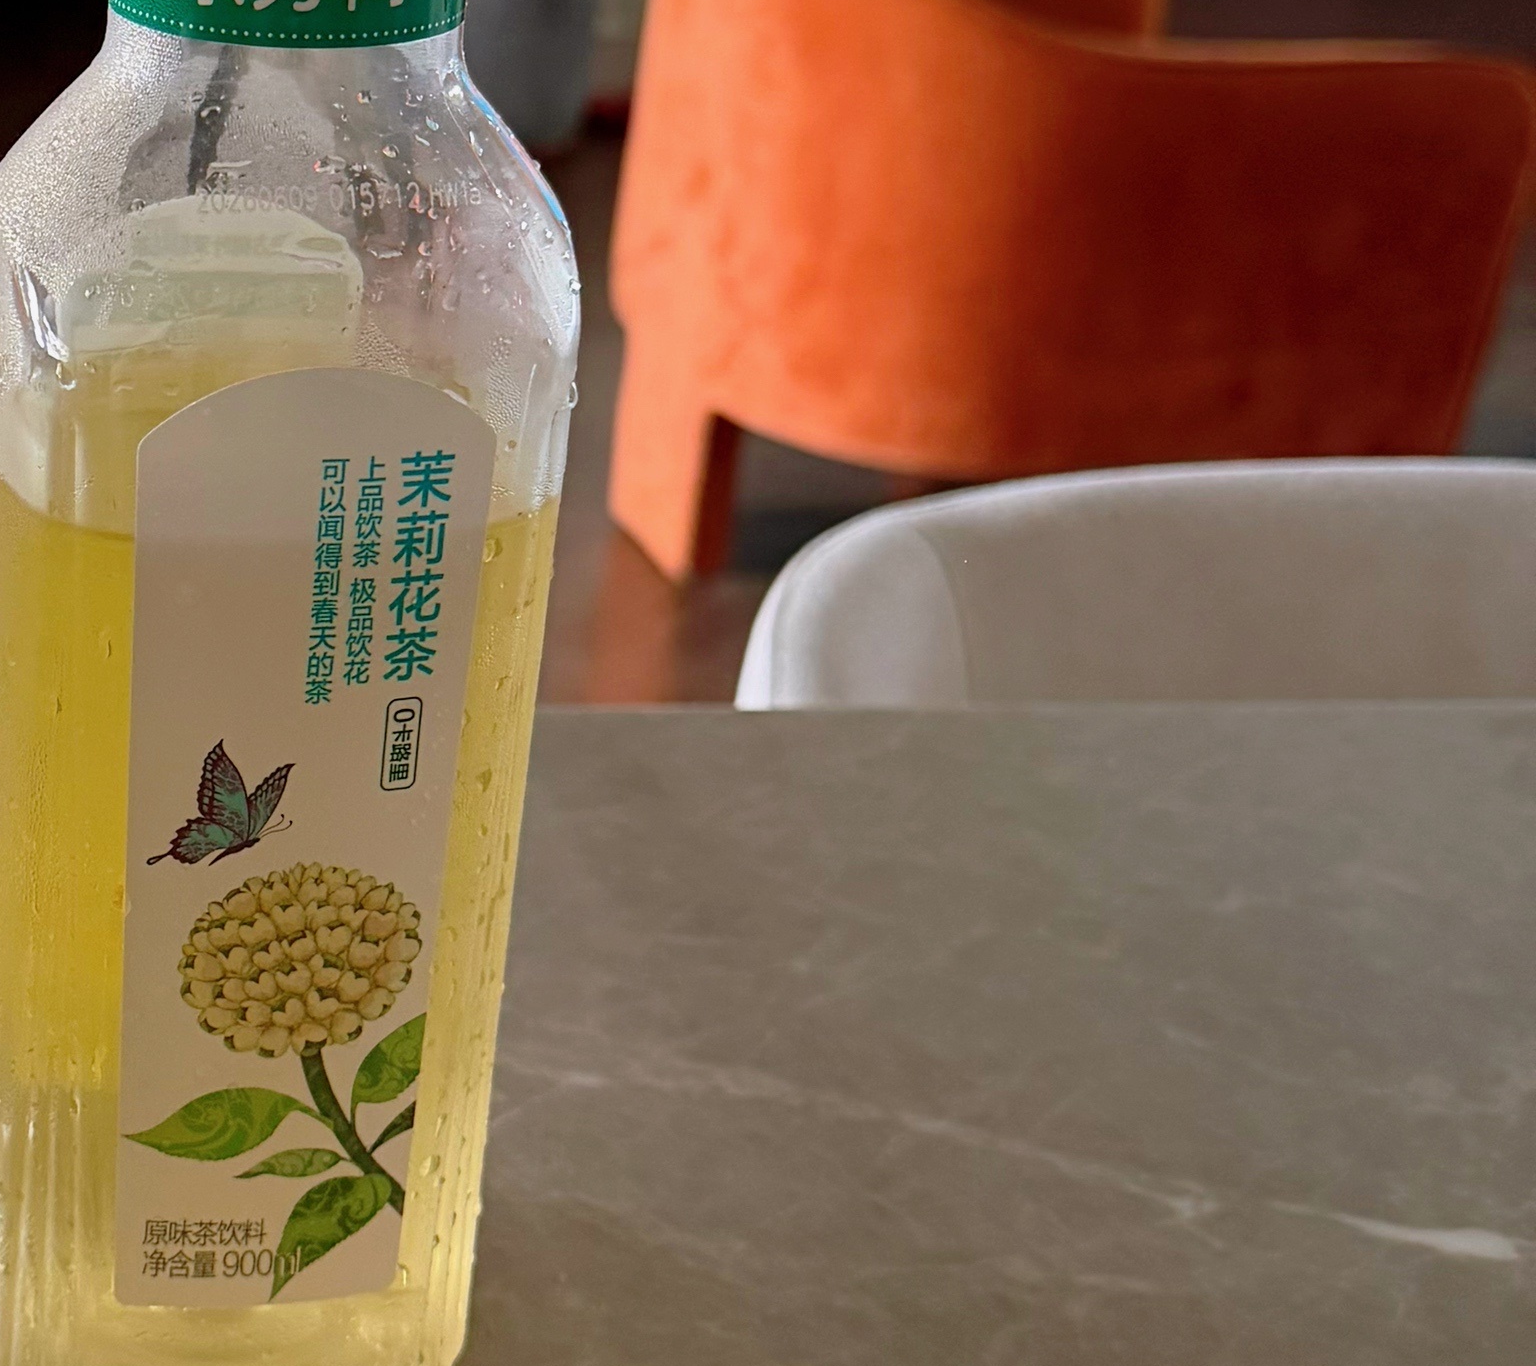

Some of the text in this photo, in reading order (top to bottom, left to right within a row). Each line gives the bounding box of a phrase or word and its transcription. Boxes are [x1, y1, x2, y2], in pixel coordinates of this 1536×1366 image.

[305, 459, 350, 705] 可以闻得到春天的茶
[343, 456, 386, 686] 上品饮茶 极品饮花
[383, 450, 456, 682] 茉莉花茶
[142, 1218, 268, 1247] 原味茶饮料
[142, 1248, 216, 1279] 净含量
